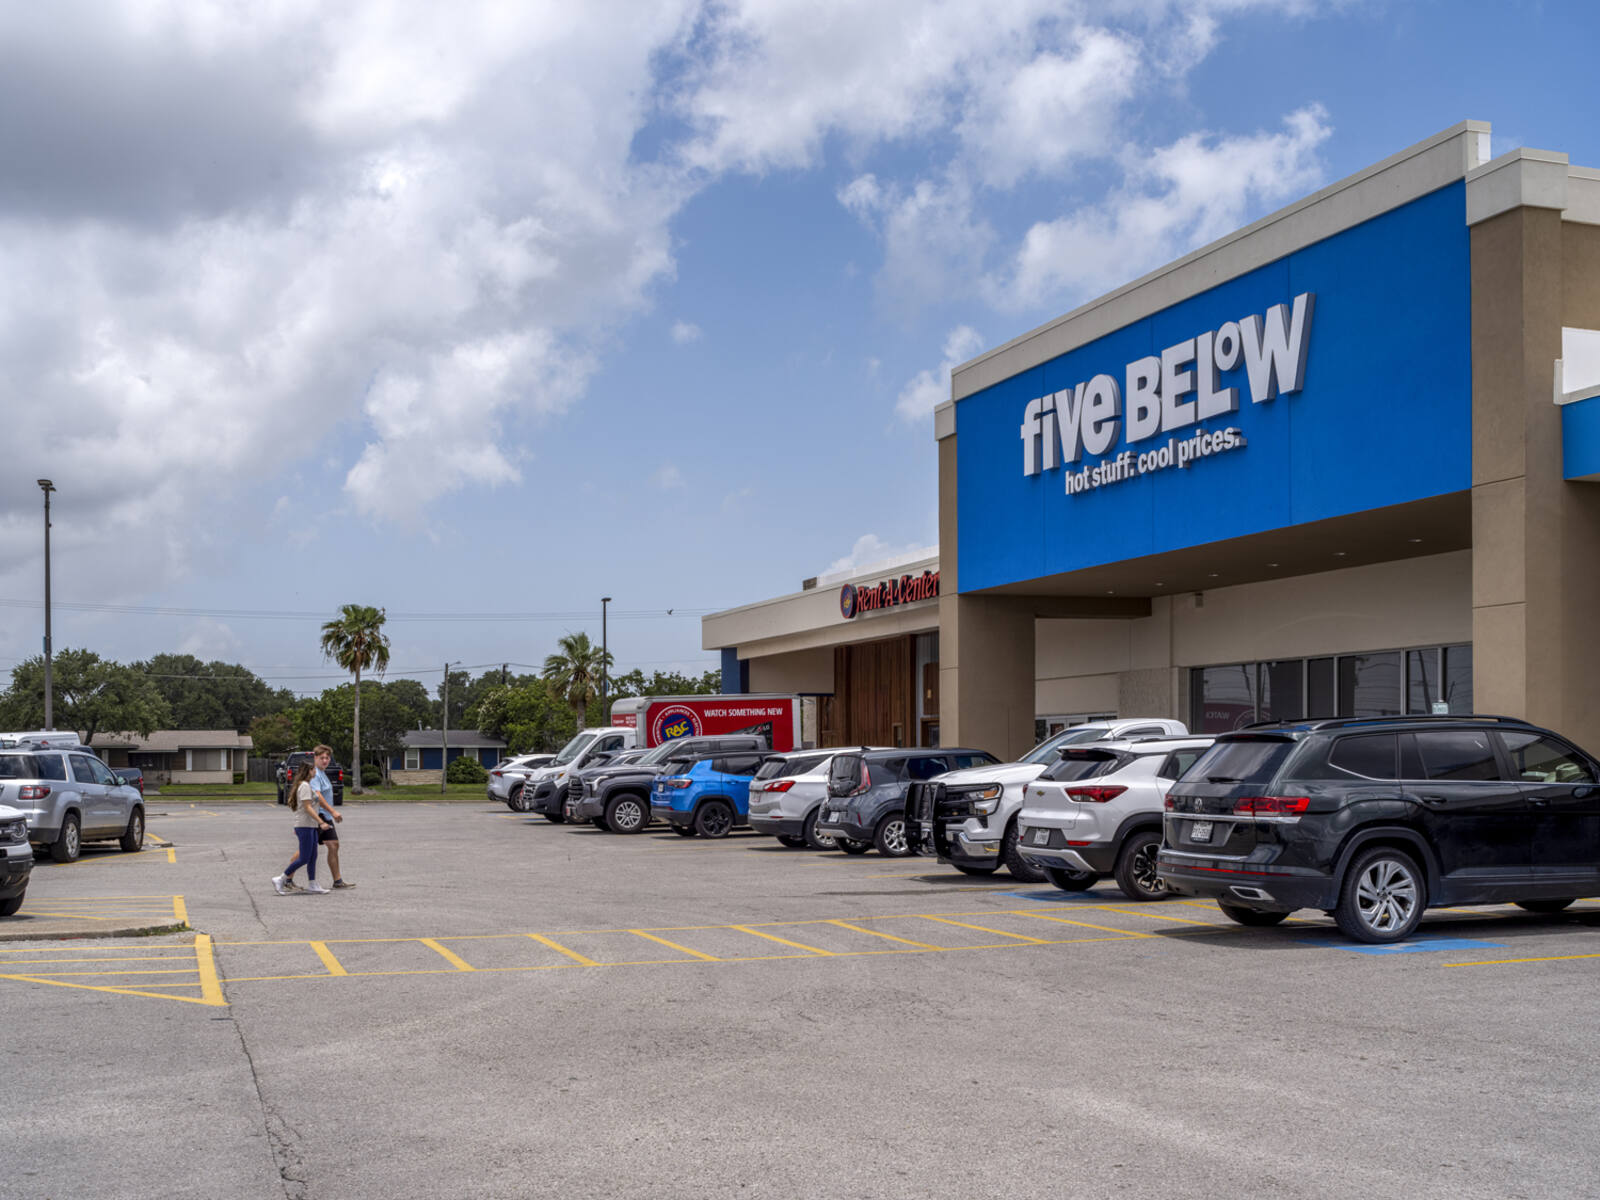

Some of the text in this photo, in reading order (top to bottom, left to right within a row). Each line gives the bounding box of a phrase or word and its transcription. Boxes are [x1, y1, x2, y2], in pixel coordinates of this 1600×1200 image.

[1065, 426, 1243, 496] hot stuff. cool prices.
[703, 707, 783, 718] WATCH SOMETHING NEW
[664, 720, 690, 738] RAC
